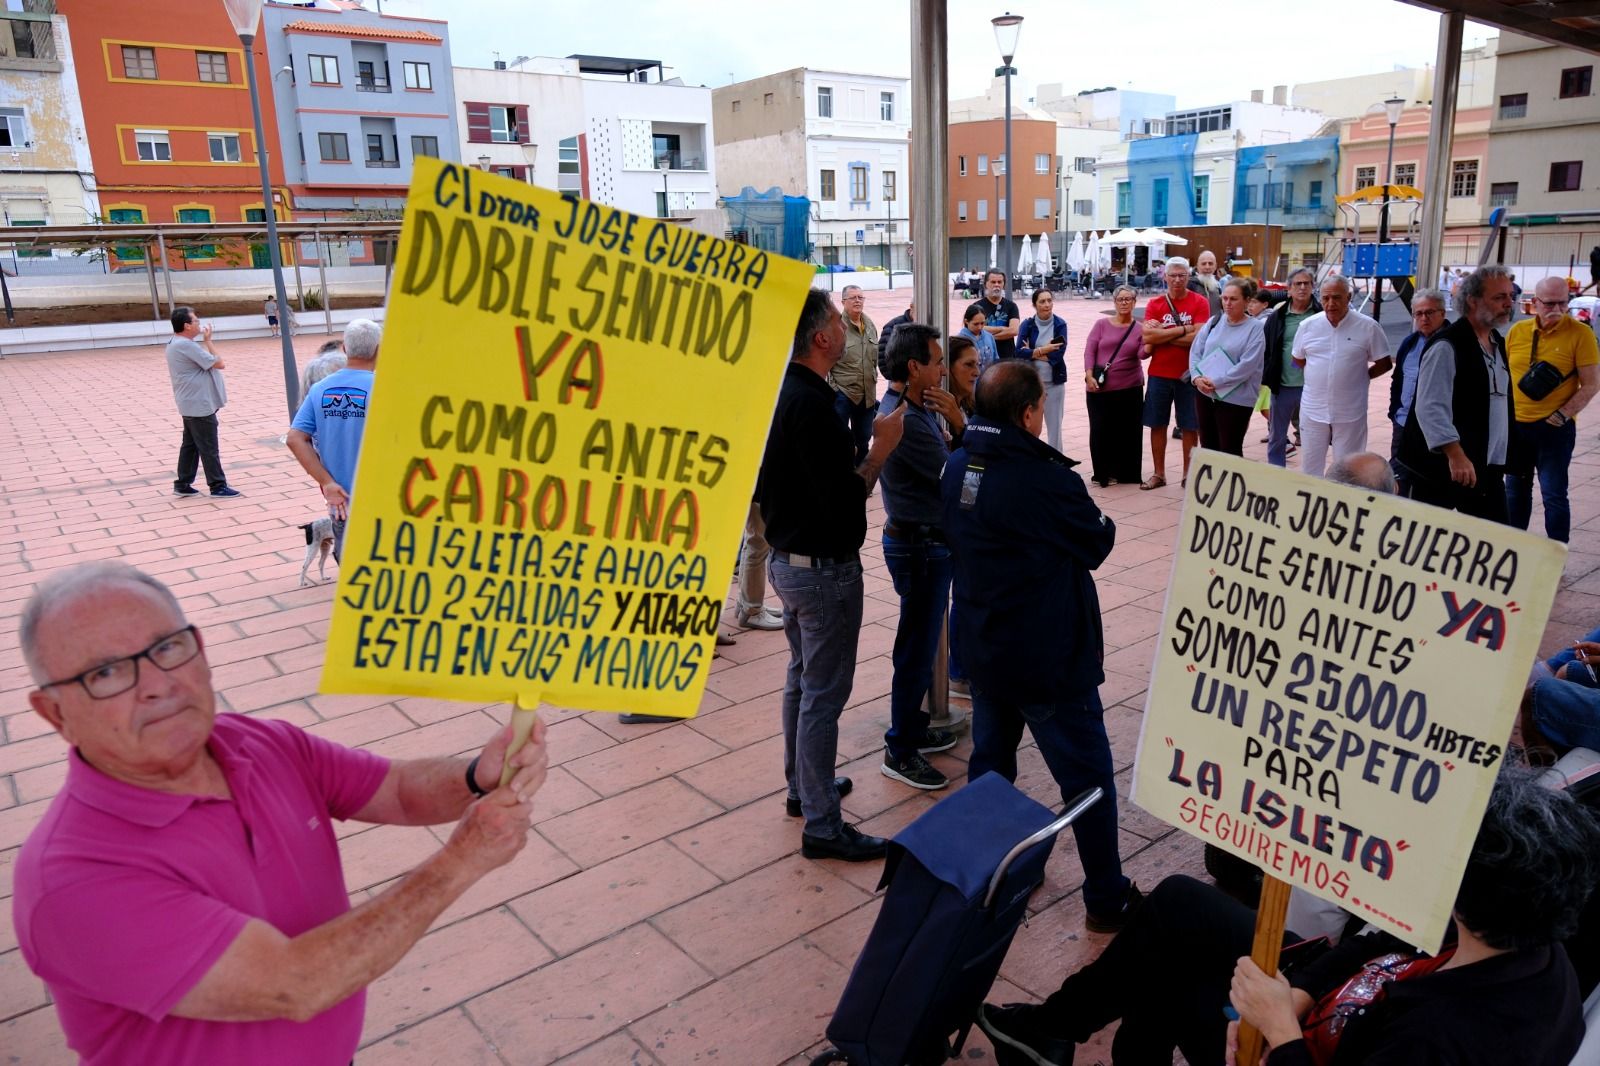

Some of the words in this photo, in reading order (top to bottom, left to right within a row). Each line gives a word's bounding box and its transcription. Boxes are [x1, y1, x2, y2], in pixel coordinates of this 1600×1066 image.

[401, 209, 566, 324] DOBLE
[478, 191, 540, 231] DTOR
[555, 194, 638, 255] JOSE
[645, 222, 769, 290] GUERRA
[514, 326, 604, 410] YA
[323, 409, 366, 419] patagonia
[420, 395, 557, 464] COMO
[580, 418, 730, 490] ANTES
[977, 425, 1001, 435] HANSEN
[370, 518, 416, 566] LA
[594, 546, 706, 593] AHOGA
[1190, 515, 1276, 580] DOBLE
[1289, 490, 1377, 553] JOSÉ
[1379, 514, 1519, 596] GUERRA
[341, 565, 432, 616] SOLO
[441, 574, 467, 620] 2
[470, 576, 603, 631] SALIDAS
[610, 591, 634, 633] Y
[630, 592, 724, 639] ATASCO
[353, 615, 441, 674] ESTA
[451, 623, 499, 677] EN
[502, 628, 570, 683] SUS
[573, 634, 704, 692] MANOS
[1171, 607, 1281, 689] SOMOS
[1423, 722, 1501, 769] HBTES
[1243, 735, 1342, 810] PARA
